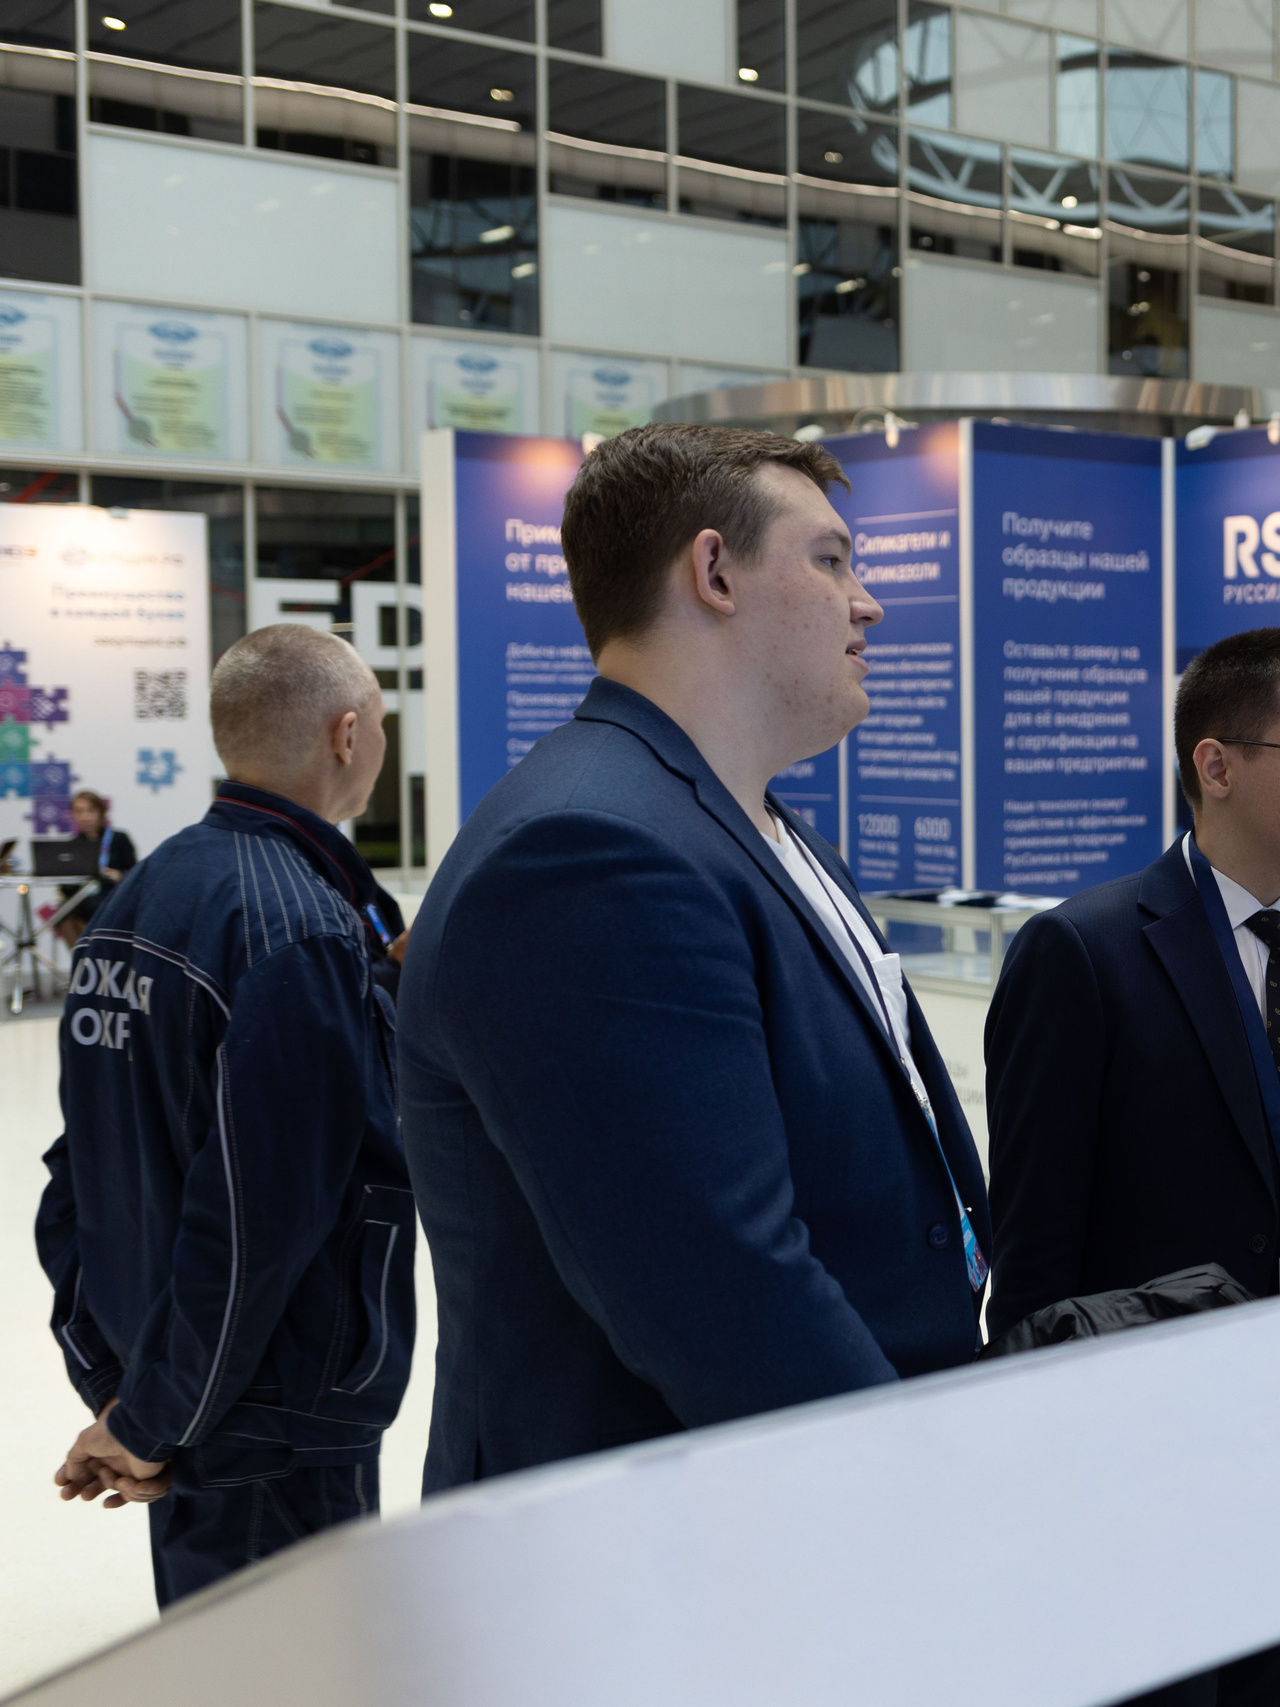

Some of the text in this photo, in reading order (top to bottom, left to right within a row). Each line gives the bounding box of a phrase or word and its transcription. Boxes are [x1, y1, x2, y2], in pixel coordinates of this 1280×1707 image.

[1002, 511, 1094, 543] Получите
[854, 530, 952, 557] Силикагели и
[505, 552, 532, 573] от
[1002, 542, 1150, 573] образцы нашей
[855, 561, 941, 585] Силиказоли
[1002, 577, 1106, 604] продукции
[1003, 664, 1148, 685] получение образцов
[1003, 686, 1130, 708] нашей продукции
[857, 813, 900, 838] 12000
[914, 816, 951, 841] 6000
